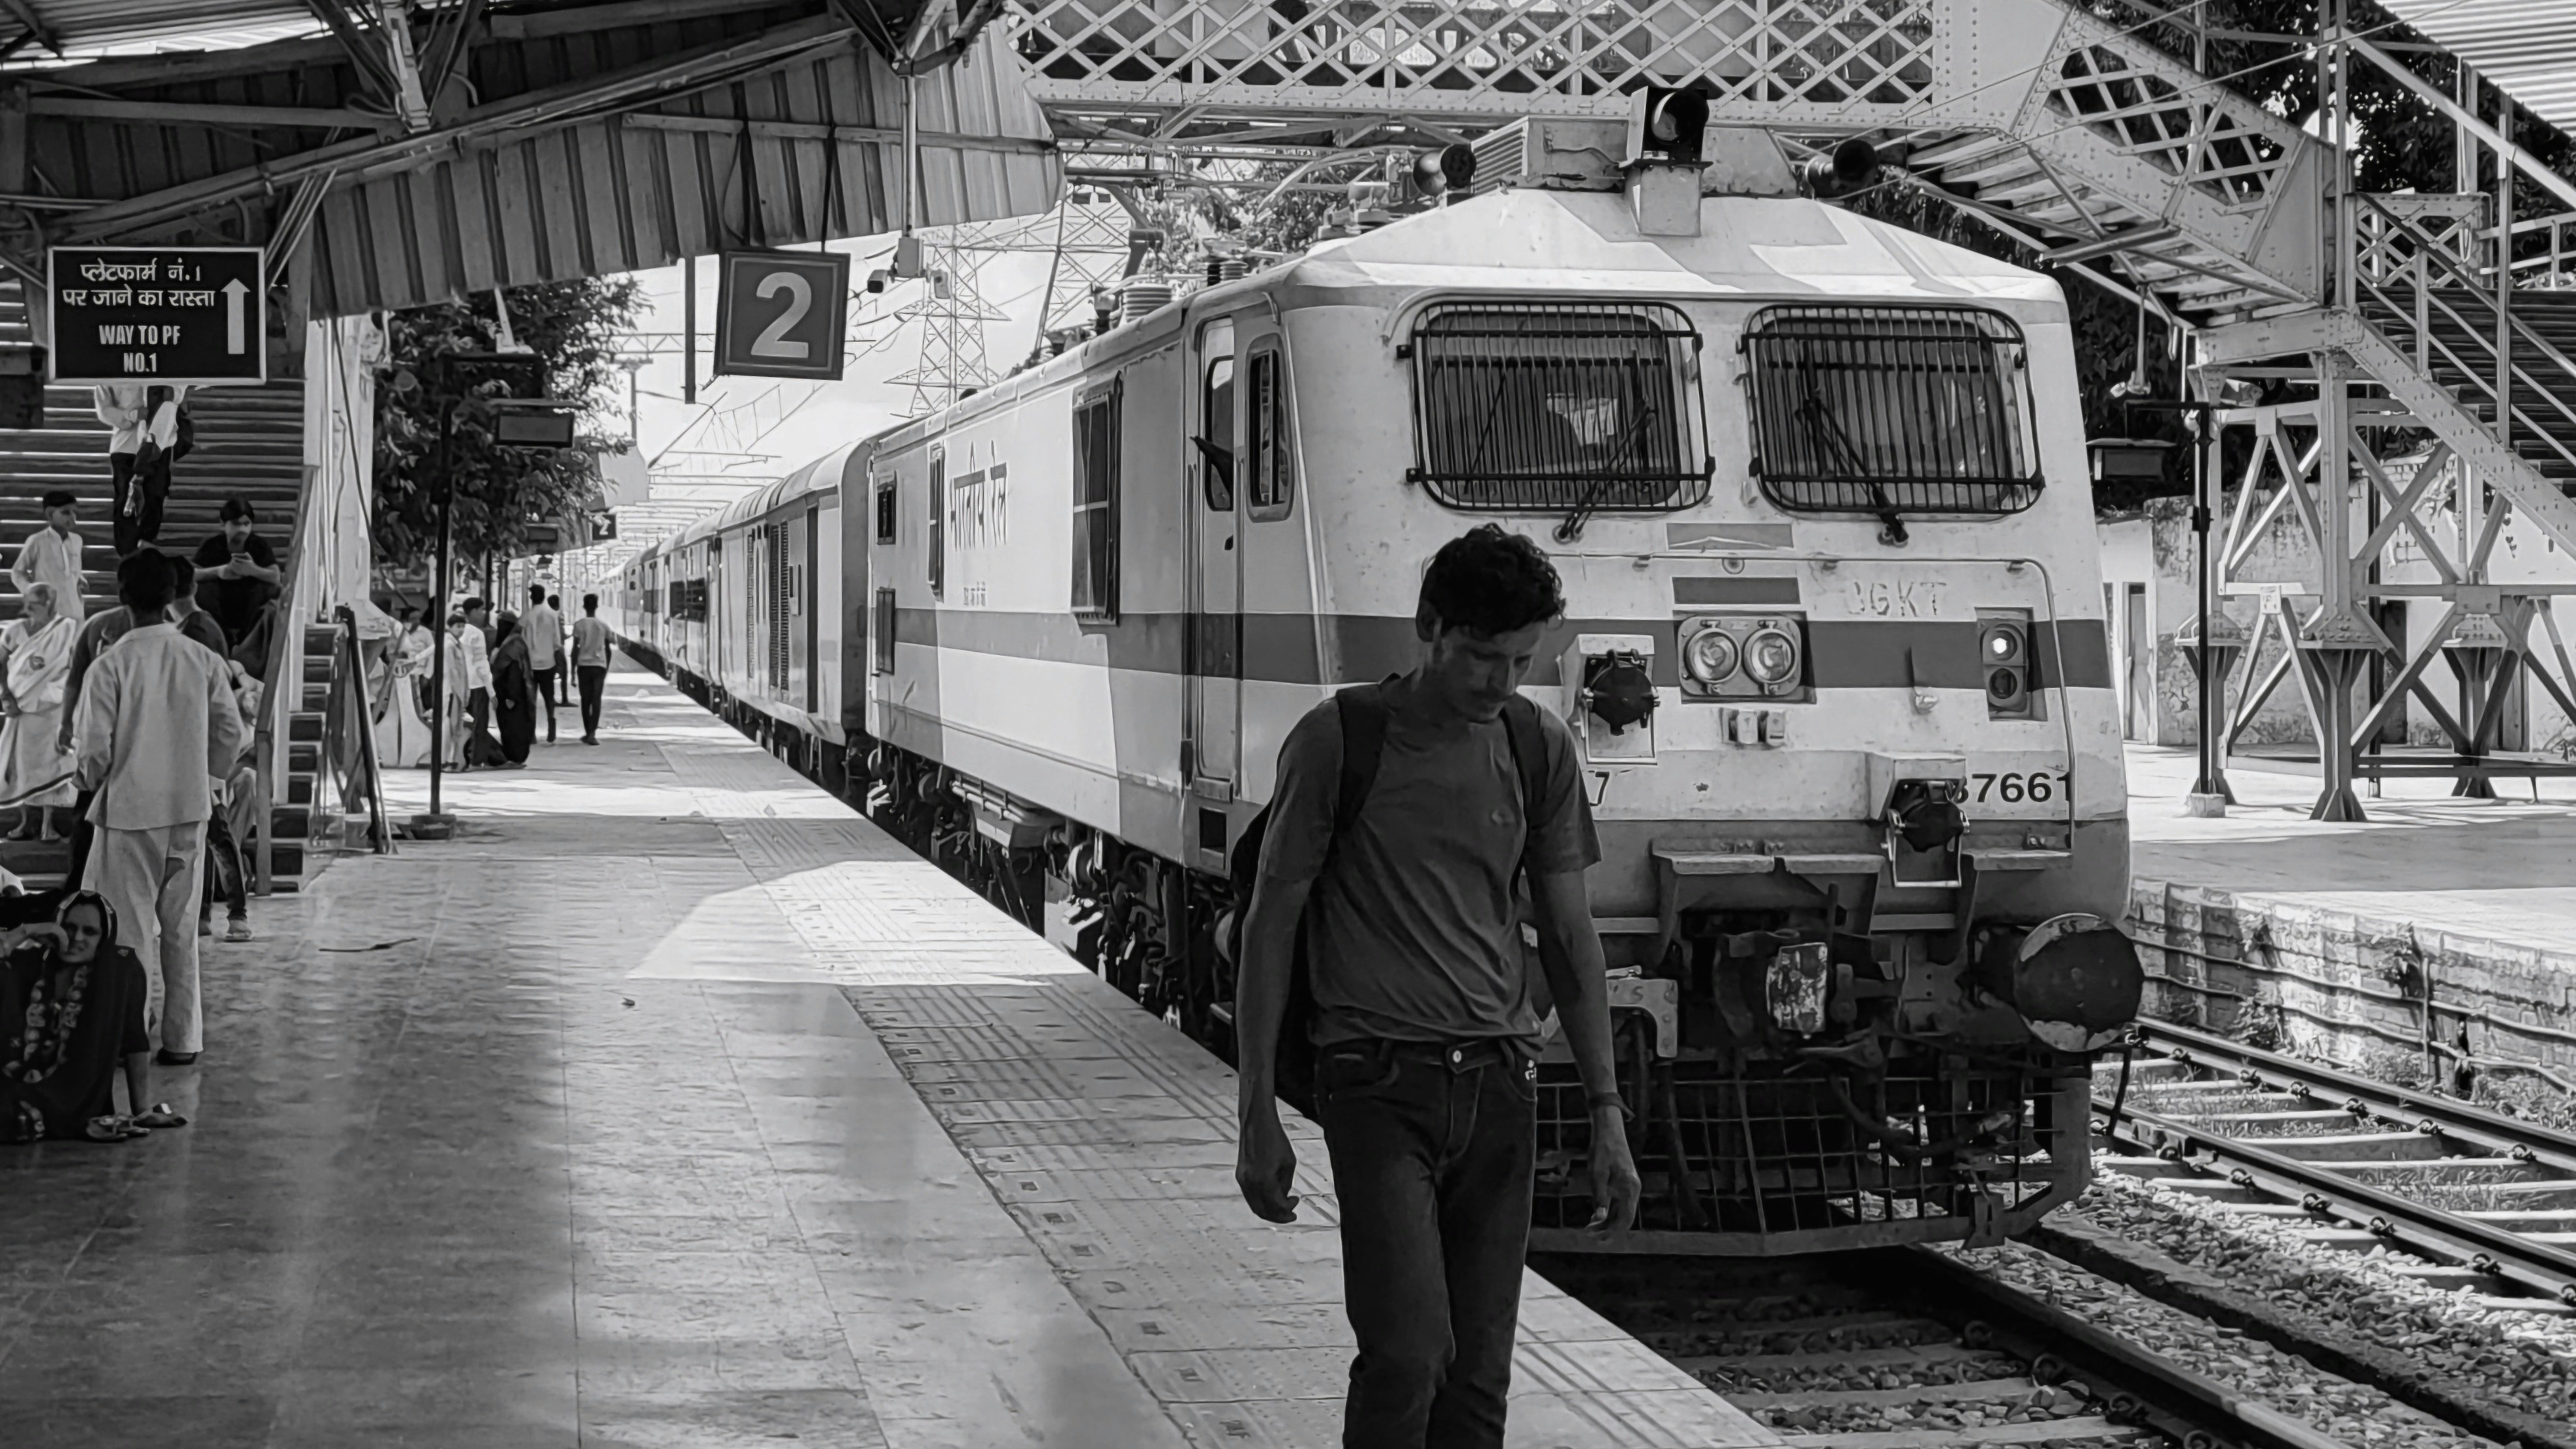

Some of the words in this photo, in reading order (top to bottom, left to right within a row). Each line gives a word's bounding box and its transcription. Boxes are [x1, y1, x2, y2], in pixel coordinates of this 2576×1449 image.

[80, 257, 157, 281] प्लेटफार्म
[63, 289, 87, 306] पर
[91, 284, 132, 306] जाने
[138, 290, 164, 306] का
[168, 290, 215, 306] रास्ता
[750, 272, 812, 359] 2
[99, 325, 134, 345] WAY
[138, 325, 158, 345] TO
[162, 325, 181, 345] PF
[123, 353, 157, 372] NO.1
